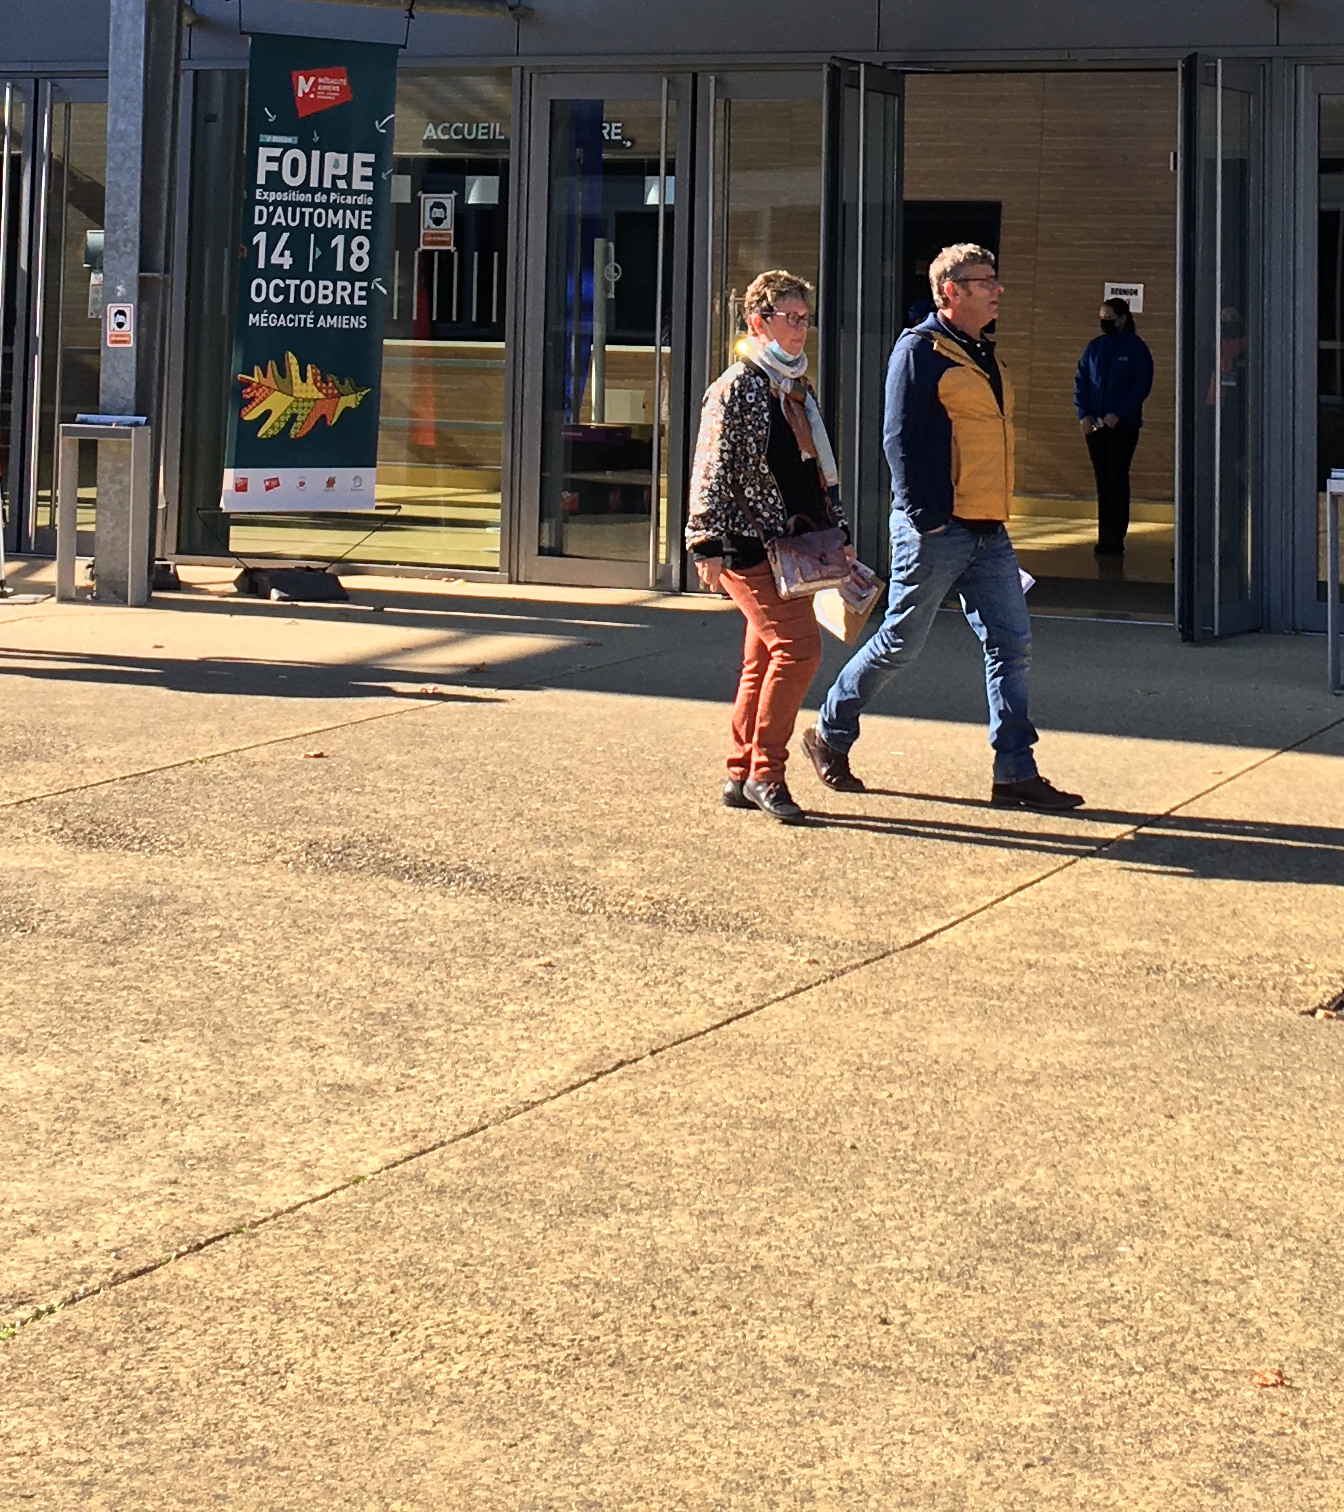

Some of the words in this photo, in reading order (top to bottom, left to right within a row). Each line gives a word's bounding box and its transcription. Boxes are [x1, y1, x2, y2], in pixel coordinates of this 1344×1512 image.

[423, 122, 505, 139] ACCUEIL
[256, 146, 376, 190] FOIRE
[256, 188, 312, 203] Exposition
[314, 191, 328, 203] de
[330, 192, 374, 205] Picardie
[254, 205, 372, 230] D'AUTOMNE
[252, 232, 293, 269] 14
[331, 234, 370, 273] 18
[250, 278, 368, 306] OCTOBRE
[248, 309, 315, 328] MÉGACITÉ
[317, 315, 368, 329] AMIENS
